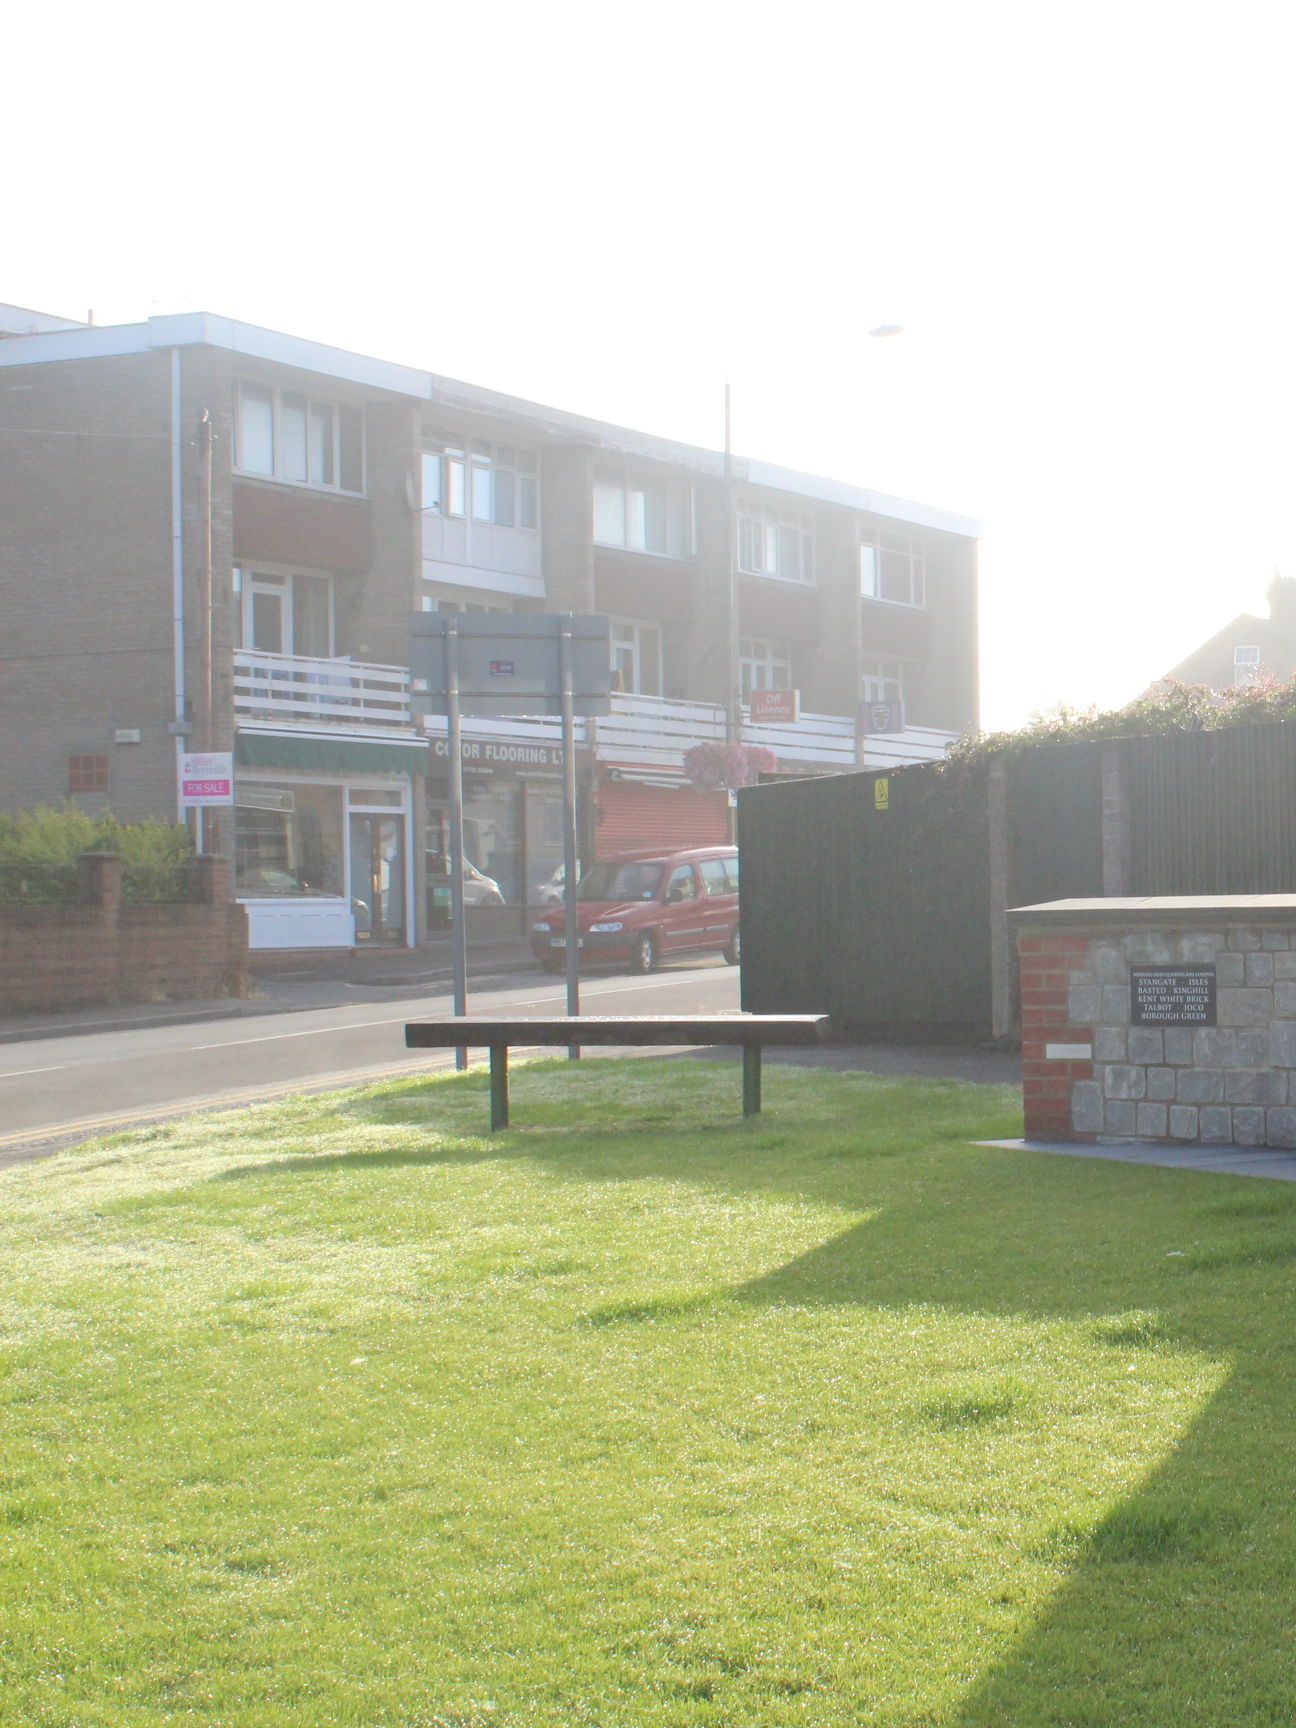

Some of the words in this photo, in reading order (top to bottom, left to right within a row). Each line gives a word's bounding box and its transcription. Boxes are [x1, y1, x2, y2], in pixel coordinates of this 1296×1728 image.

[766, 694, 782, 703] Off
[756, 704, 790, 714] Licence
[435, 741, 480, 758] COOR
[486, 745, 547, 763] FLOORING
[188, 783, 202, 793] FOR
[204, 782, 224, 793] SALE
